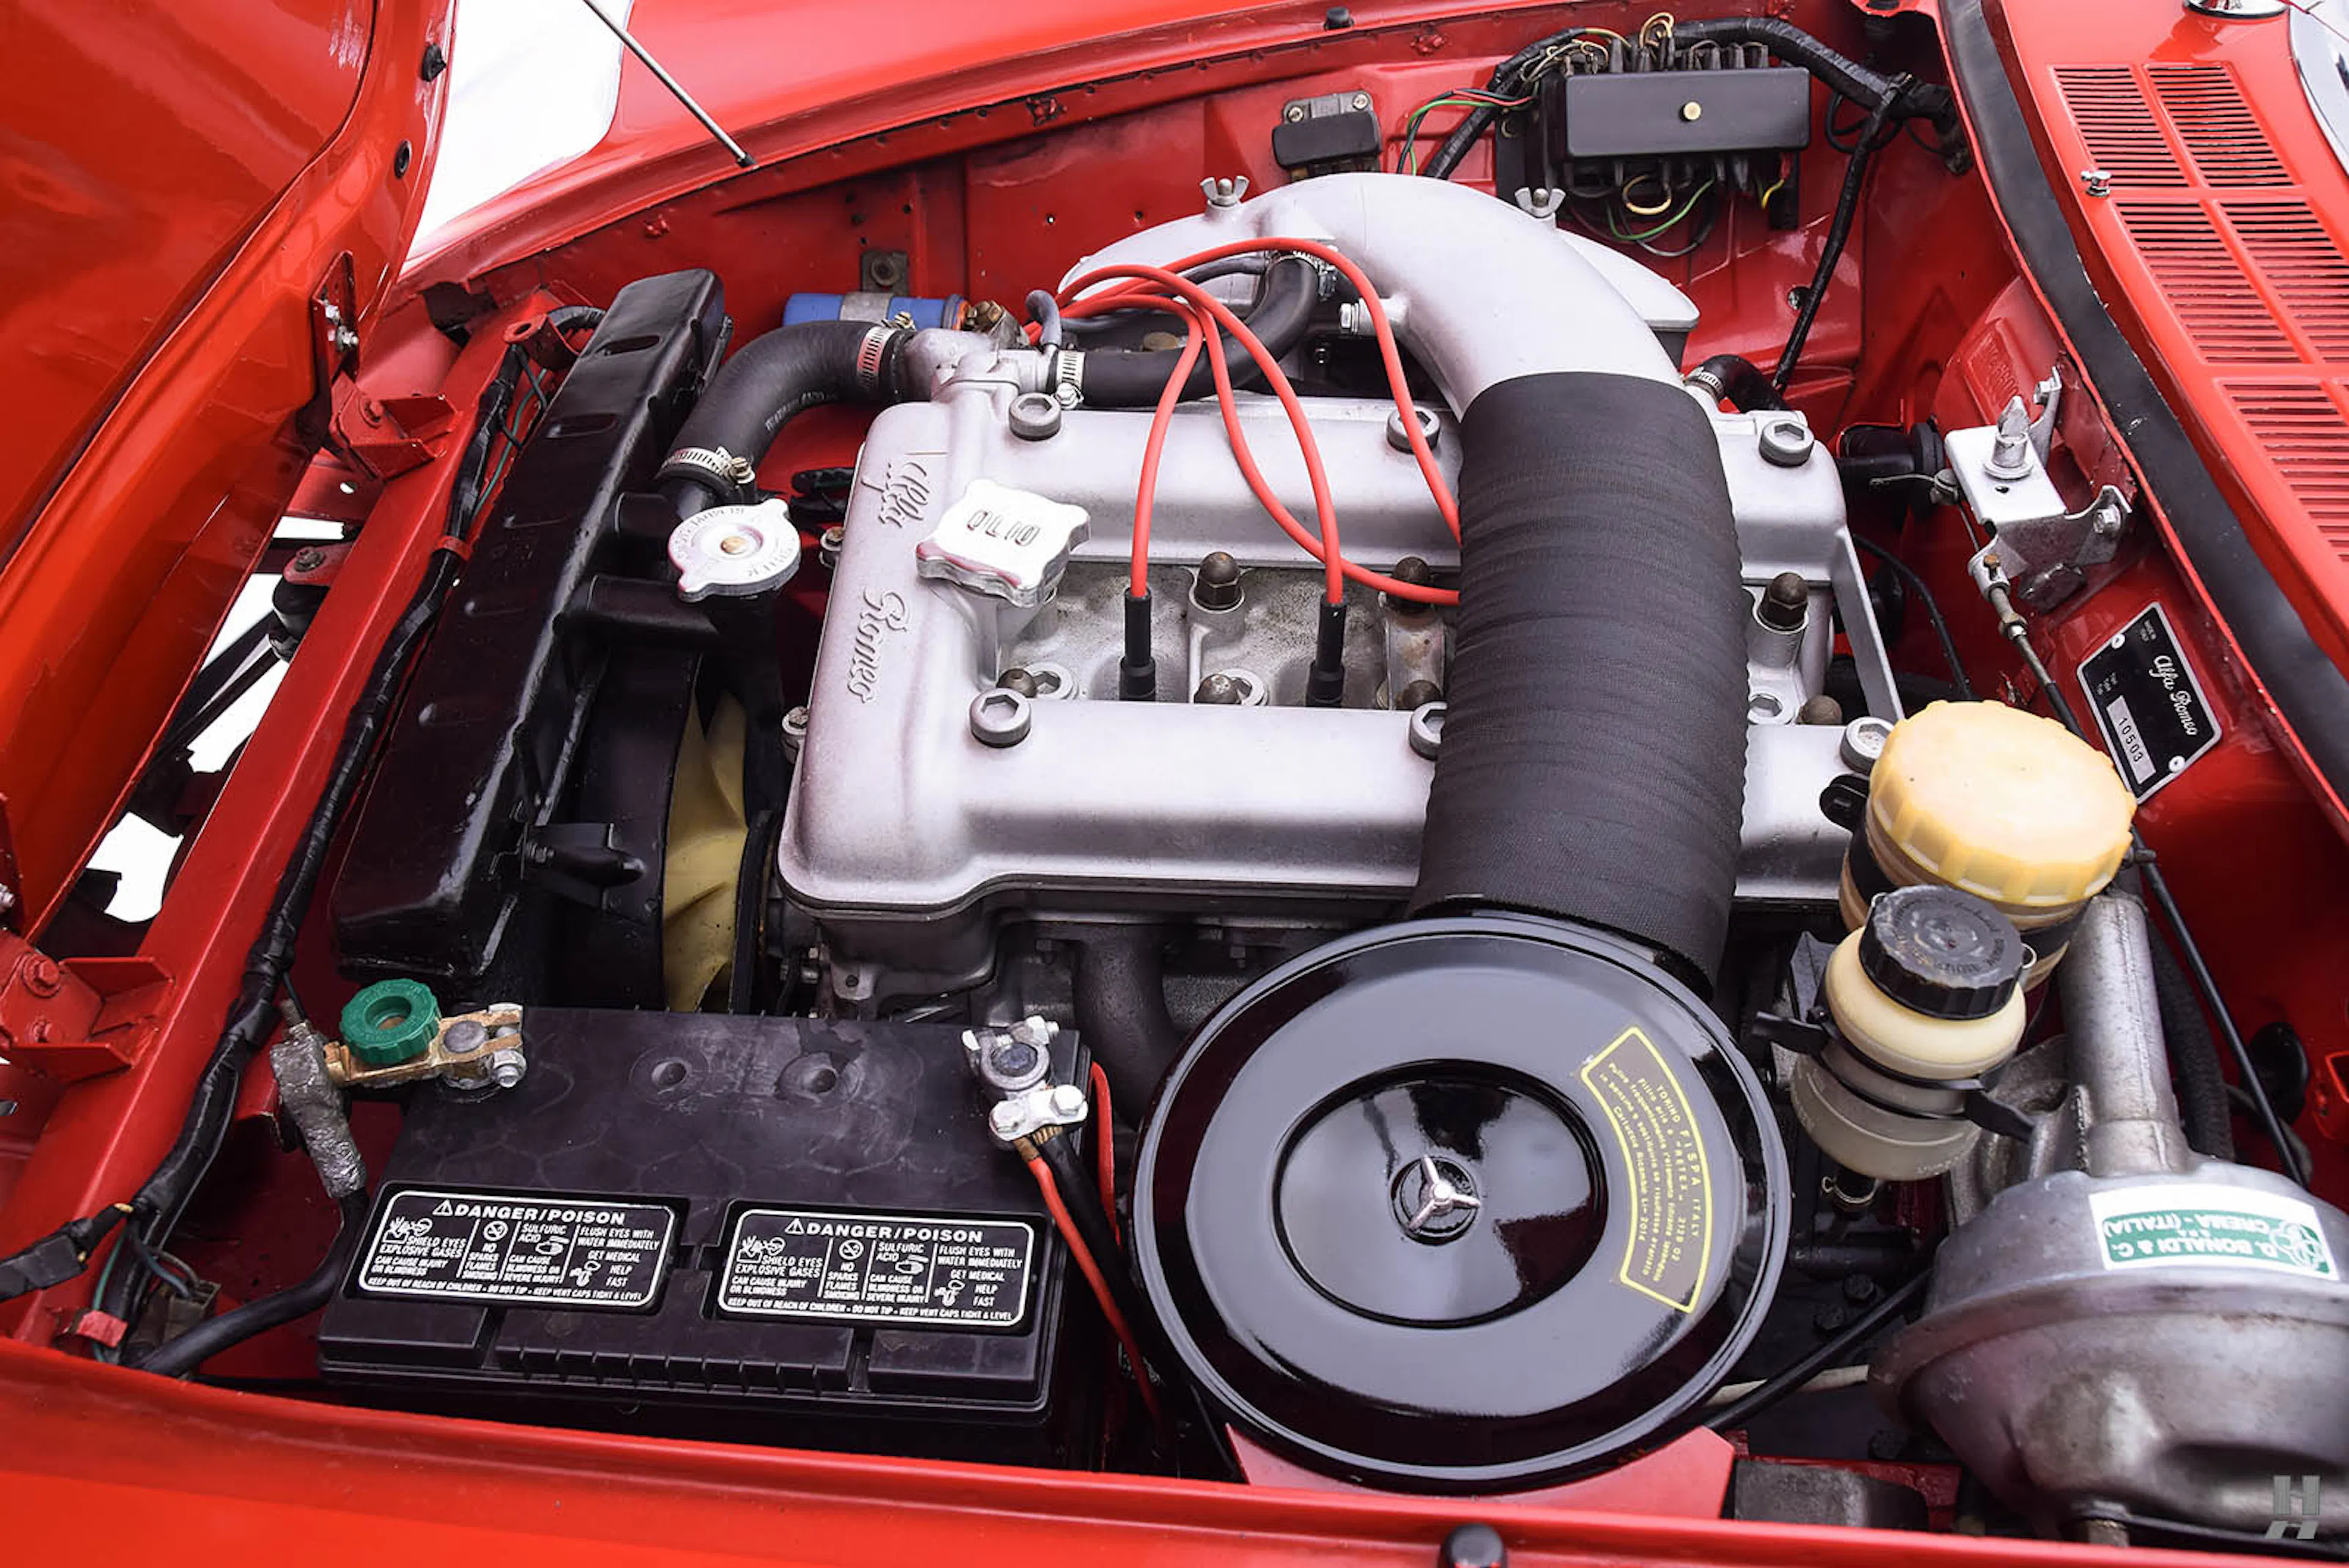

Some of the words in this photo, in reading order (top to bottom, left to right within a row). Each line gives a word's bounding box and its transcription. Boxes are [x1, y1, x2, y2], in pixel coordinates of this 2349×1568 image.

[967, 508, 1041, 546] OLIO
[847, 587, 908, 704] Romeo
[2148, 655, 2176, 690] Alfa
[2170, 690, 2199, 735] Romeo
[2118, 717, 2142, 762] 10503
[1657, 1085, 1680, 1123] TORINO
[1680, 1129, 1701, 1186] FISPA
[1691, 1198, 1701, 1237] ITALY
[455, 1203, 625, 1224] DANGER/POISON
[521, 1224, 567, 1235] SULFURIC
[2194, 1213, 2269, 1234] CREMA
[518, 1233, 541, 1243] ACID
[580, 1227, 607, 1237] FLUSH
[608, 1228, 630, 1238] EYES
[632, 1229, 654, 1239] WITH
[806, 1222, 983, 1243] DANGER/POISON
[406, 1236, 440, 1247] SHIELD
[442, 1237, 467, 1249] EYES
[482, 1243, 497, 1253] NO
[577, 1237, 606, 1247] WATER
[606, 1238, 660, 1250] IMMEDIATELY
[878, 1241, 924, 1254] SULFURIC
[2156, 1238, 2254, 1255] BONALDI
[379, 1244, 429, 1256] EXPLOSIVE
[431, 1246, 463, 1258] GASES
[468, 1252, 499, 1262] SPARKS
[587, 1250, 605, 1260] GET
[605, 1252, 640, 1263] MEDICAL
[875, 1252, 900, 1262] ACID
[939, 1244, 967, 1255] FLUSH
[968, 1246, 990, 1257] EYES
[992, 1247, 1015, 1258] WITH
[465, 1261, 497, 1271] FLAMES
[526, 1256, 551, 1265] CAUSE
[761, 1255, 795, 1266] SHIELD
[798, 1256, 823, 1268] EYES
[841, 1261, 855, 1272] NO
[937, 1255, 965, 1266] WATER
[968, 1257, 1023, 1269] IMMEDIATELY
[609, 1265, 633, 1275] HELP
[735, 1263, 786, 1276] EXPLOSIVE
[789, 1267, 820, 1279] GASES
[950, 1269, 967, 1279] GET
[968, 1270, 1005, 1282] MEDICAL
[503, 1273, 532, 1282] SEVERE
[606, 1277, 628, 1287] FAST
[732, 1276, 749, 1285] CAN
[827, 1271, 858, 1282] SPARKS
[869, 1274, 886, 1283] CAN
[887, 1274, 913, 1284] CAUSE
[825, 1280, 857, 1291] FLAMES
[974, 1284, 998, 1295] HELP
[865, 1292, 896, 1302] SEVERE
[973, 1296, 995, 1307] FAST
